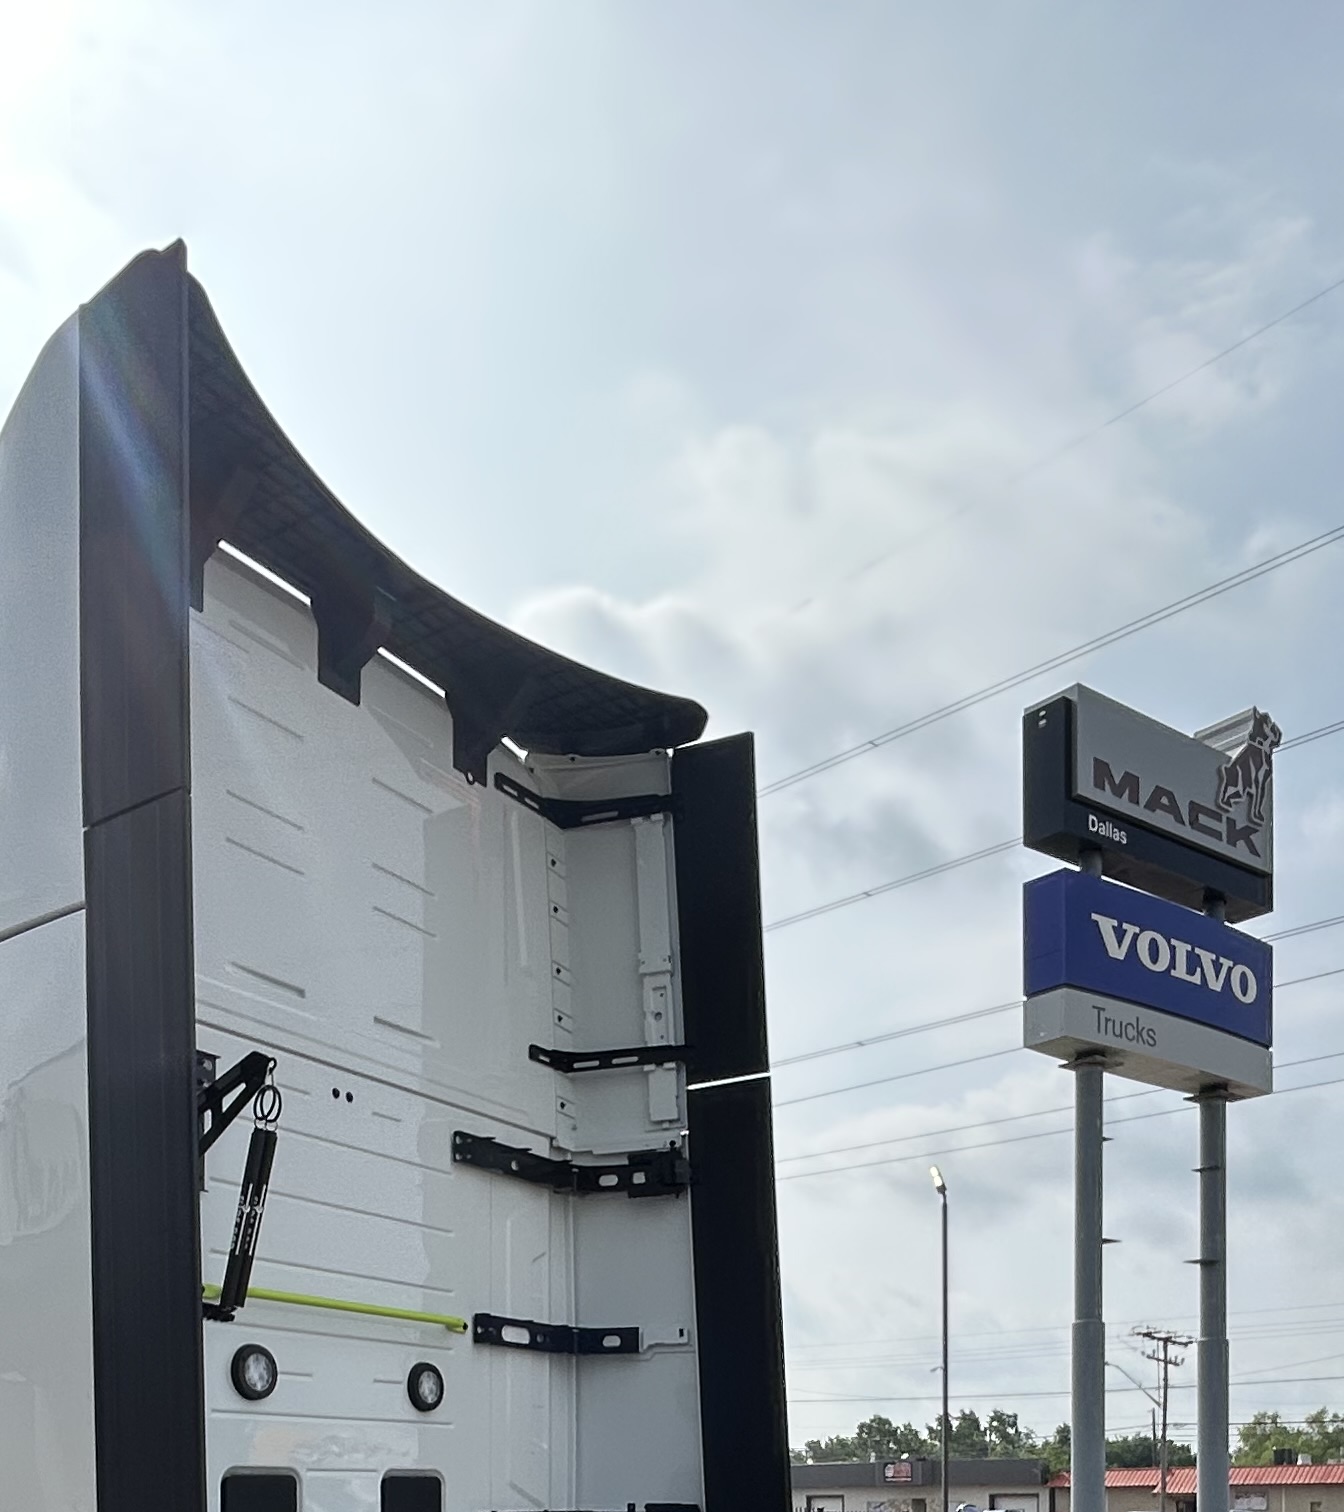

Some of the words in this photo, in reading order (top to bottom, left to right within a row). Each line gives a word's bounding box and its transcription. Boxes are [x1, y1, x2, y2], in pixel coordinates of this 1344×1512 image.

[1088, 814, 1127, 846] Dallas
[1092, 756, 1262, 858] MACK
[1091, 912, 1258, 1005] VOLVO
[1092, 1005, 1157, 1048] Trucks
